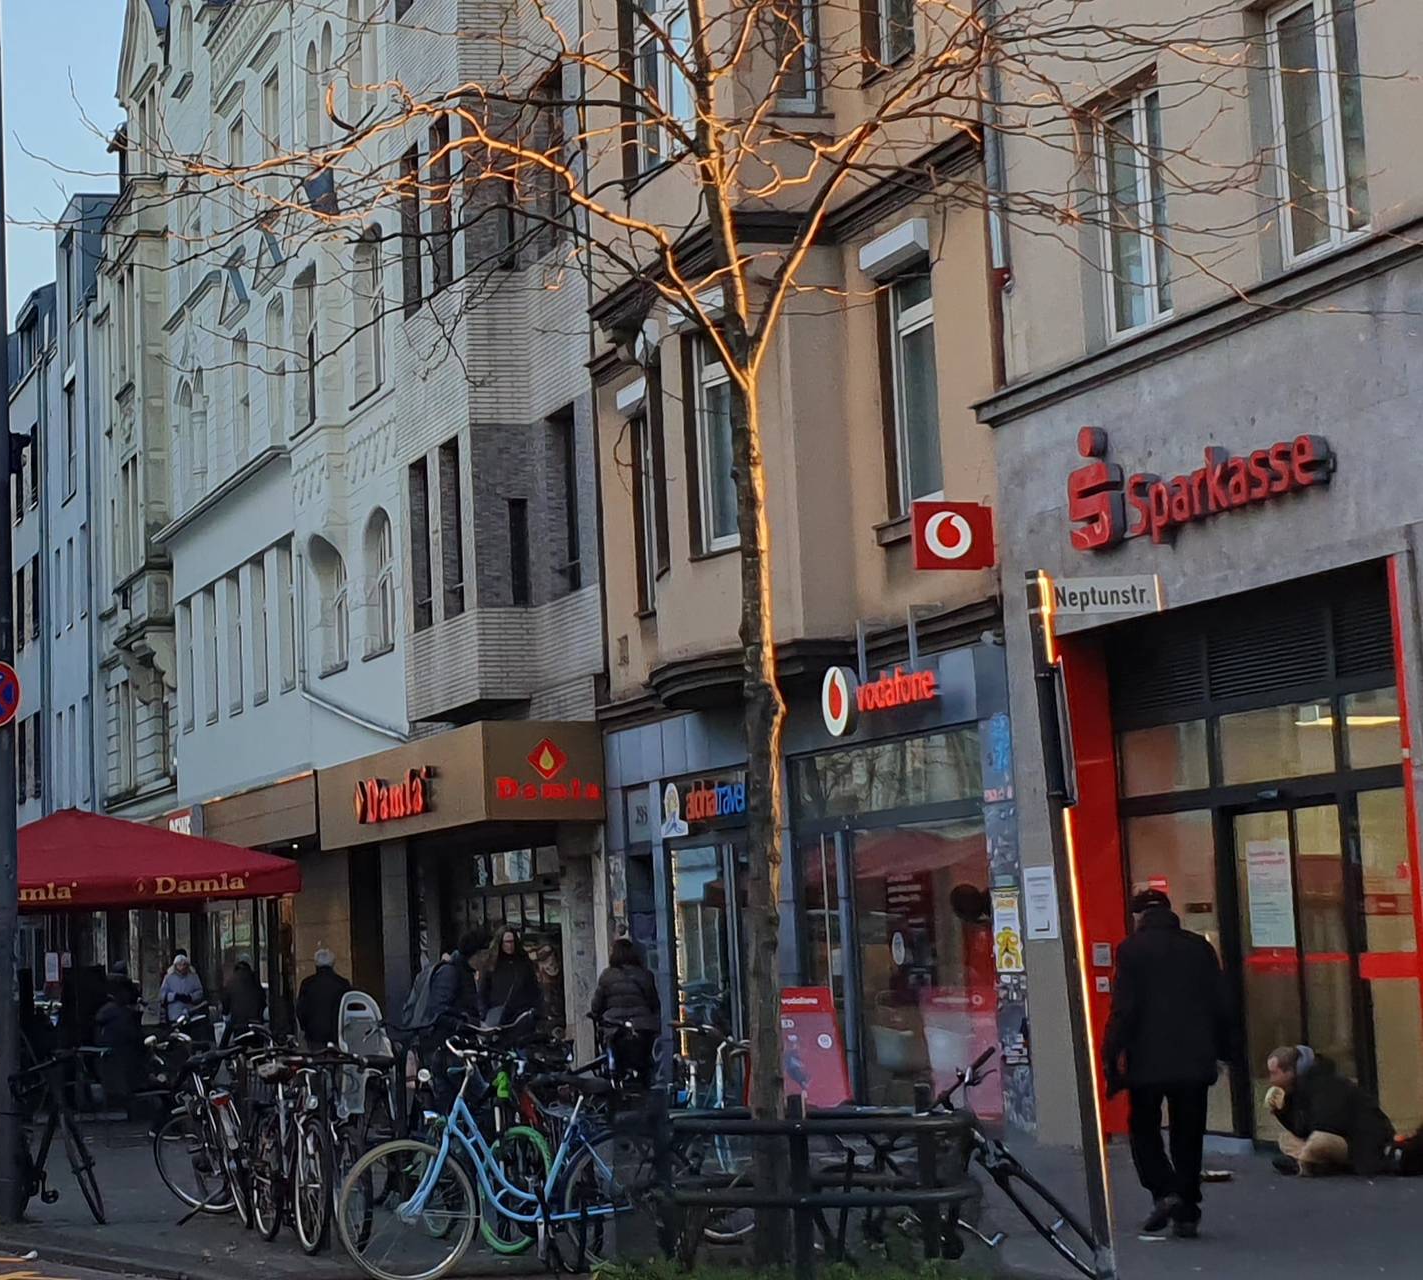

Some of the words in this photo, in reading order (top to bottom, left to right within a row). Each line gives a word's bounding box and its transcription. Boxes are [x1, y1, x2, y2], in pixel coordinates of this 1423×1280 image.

[1128, 434, 1320, 545] Sparkasse
[1055, 585, 1150, 611] Neptunstr.
[855, 665, 936, 712] vodafone
[365, 768, 429, 825] Damla
[495, 777, 601, 801] Damla
[155, 872, 246, 895] Damla
